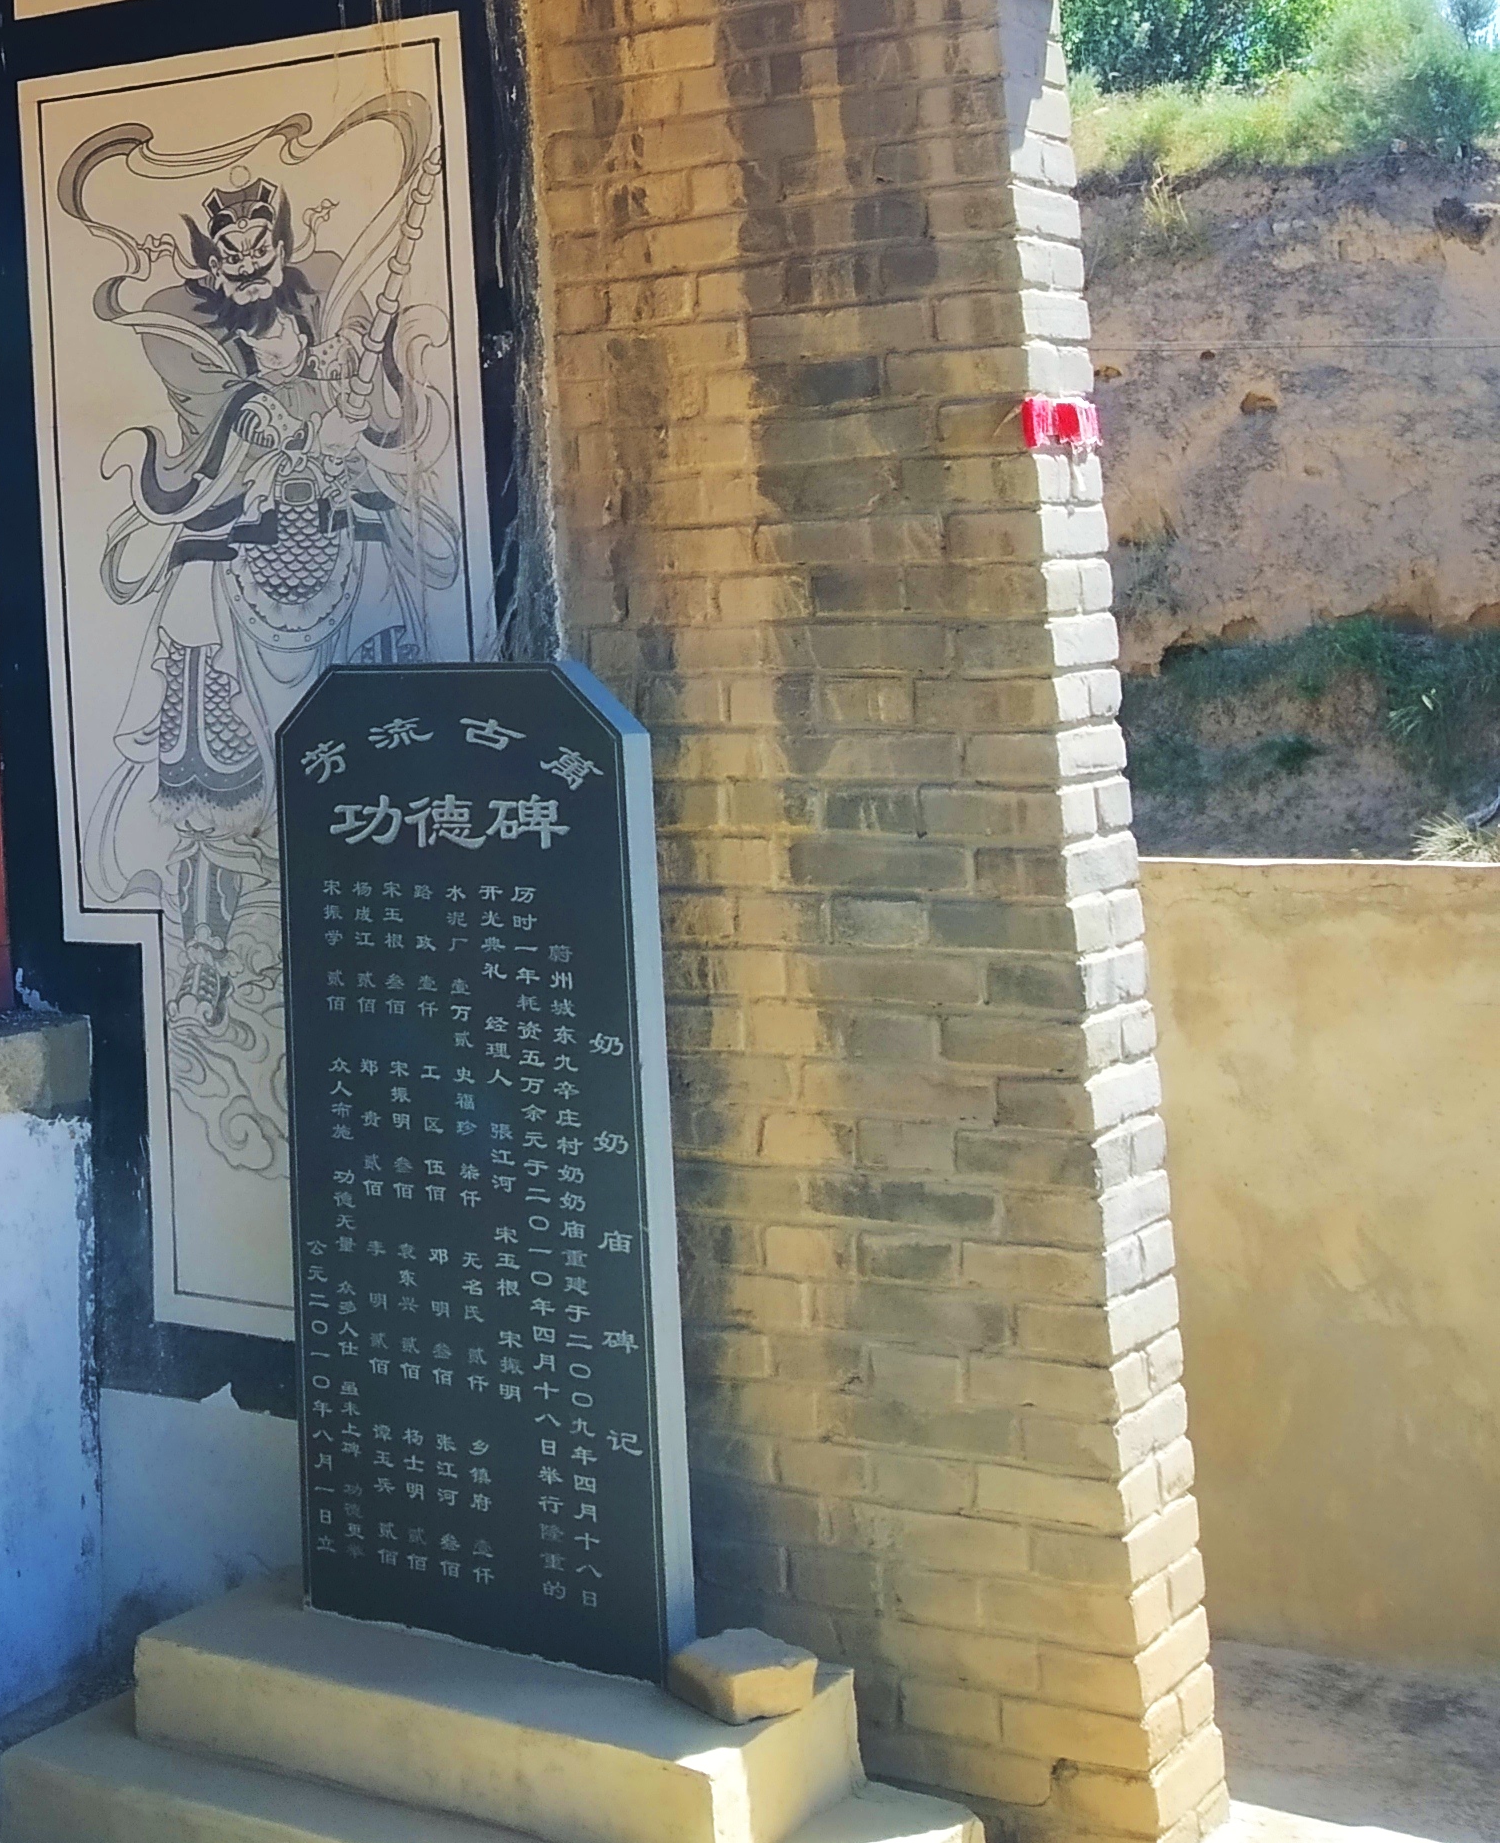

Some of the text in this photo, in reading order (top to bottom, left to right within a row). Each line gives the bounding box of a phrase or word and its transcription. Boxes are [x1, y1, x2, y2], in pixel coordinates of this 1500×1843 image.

[330, 794, 570, 849] 功德碑
[323, 880, 343, 946] 宋振学
[352, 881, 375, 947] 杨成江
[382, 881, 404, 949] 宋玉根
[445, 885, 468, 952] 水泥厂
[385, 973, 405, 1015] 叁佰
[328, 1057, 354, 1140] 众人布施
[360, 1058, 381, 1127] 郑贵
[389, 1061, 411, 1130] 宋振明
[453, 1066, 477, 1136] 史福珍
[393, 1156, 414, 1199] 叁佰
[478, 885, 524, 1403] 开光典礼 经理人 張江河 宋玉根 宋振明
[333, 1169, 356, 1252] 功德无量
[459, 1163, 481, 1208] 柒仟
[414, 885, 461, 1578] 路政 壹仟 工区 伍佰 邓明 叁佰 张江河 叁佰
[589, 1032, 643, 1456] 奶奶庙碑记
[367, 1240, 387, 1310] 李明
[462, 1252, 484, 1323] 无名氏
[337, 1281, 359, 1356] 众多人仕
[307, 1240, 336, 1552] 公元二〇一〇年八月一日立
[340, 1381, 362, 1457] 虽未上碑
[402, 1428, 425, 1501] 杨士明
[469, 1439, 492, 1512] 乡镇府
[473, 1540, 494, 1584] 壹仟
